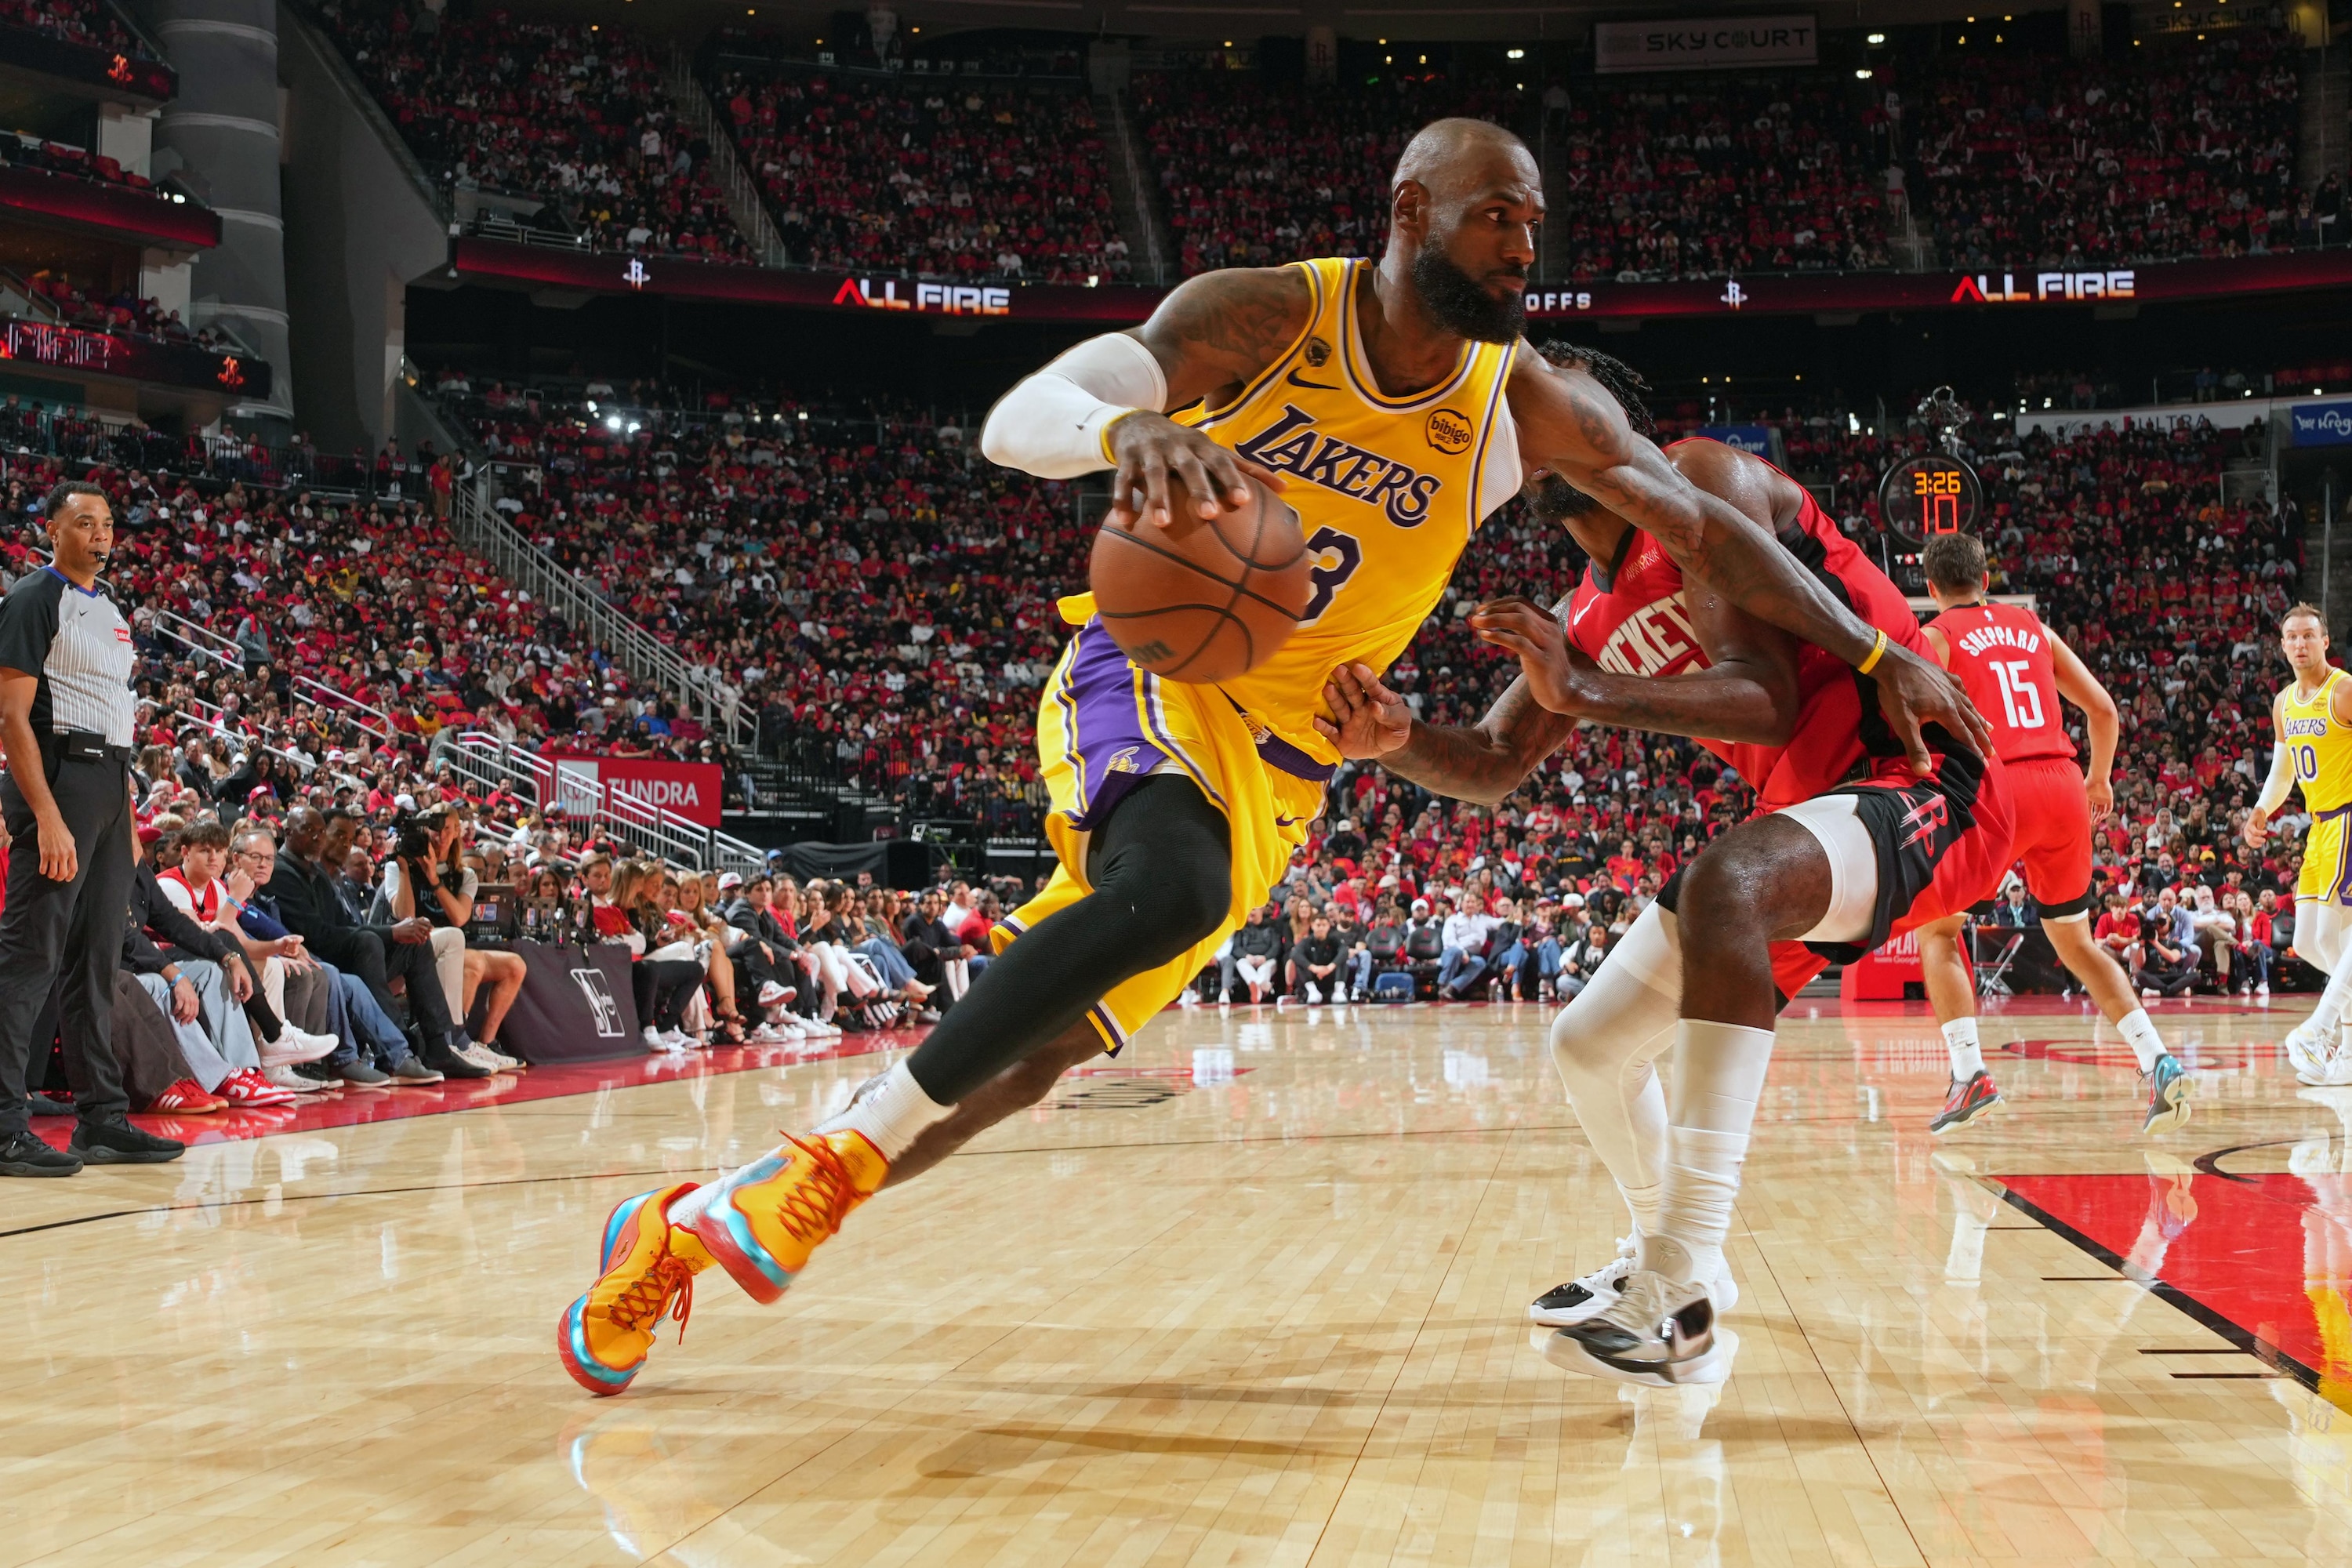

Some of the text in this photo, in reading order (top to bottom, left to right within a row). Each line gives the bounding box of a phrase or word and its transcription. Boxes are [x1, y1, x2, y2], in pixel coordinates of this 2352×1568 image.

[1646, 32, 1706, 52] SKY
[832, 277, 1011, 315] ALL FIRE
[1525, 292, 1592, 312] OFFS
[1950, 270, 2136, 303] ALL FIRE
[1431, 416, 1470, 445] bibigo
[2318, 410, 2352, 437] Krog
[1233, 401, 1444, 531] LAKERS
[1914, 470, 1962, 495] 3:26
[1922, 494, 1958, 535] 10
[1282, 500, 1364, 629] 3
[1597, 590, 1700, 678] OCKET
[1959, 626, 2040, 658] SHEPPARD
[1988, 660, 2045, 729] 15
[2285, 717, 2327, 739] LAKERS
[2291, 744, 2318, 780] 10
[607, 778, 699, 808] TUNDRA
[1886, 930, 1919, 956] PLAY
